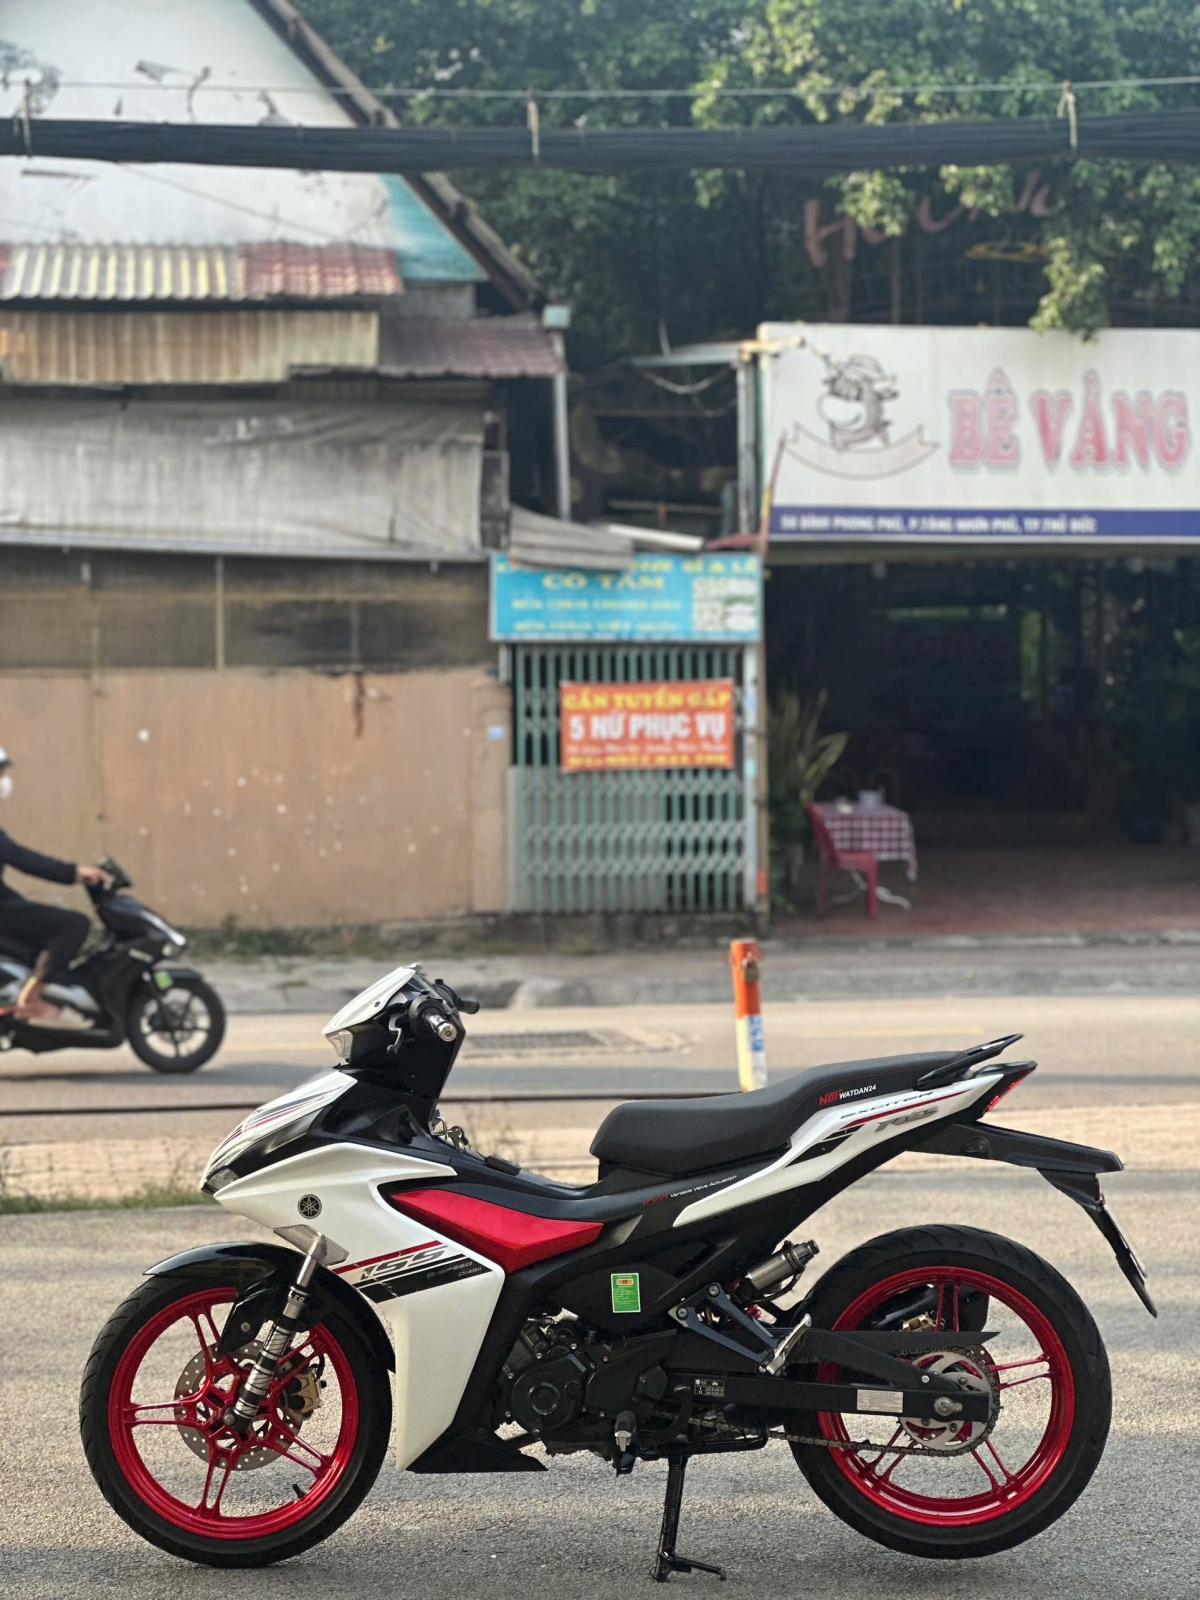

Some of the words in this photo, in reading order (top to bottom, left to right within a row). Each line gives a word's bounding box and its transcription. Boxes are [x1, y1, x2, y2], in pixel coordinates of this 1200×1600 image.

[948, 366, 1022, 470] BÊ
[569, 714, 585, 741] 5
[629, 712, 692, 745] PHỤC
[695, 711, 727, 744] VỤ
